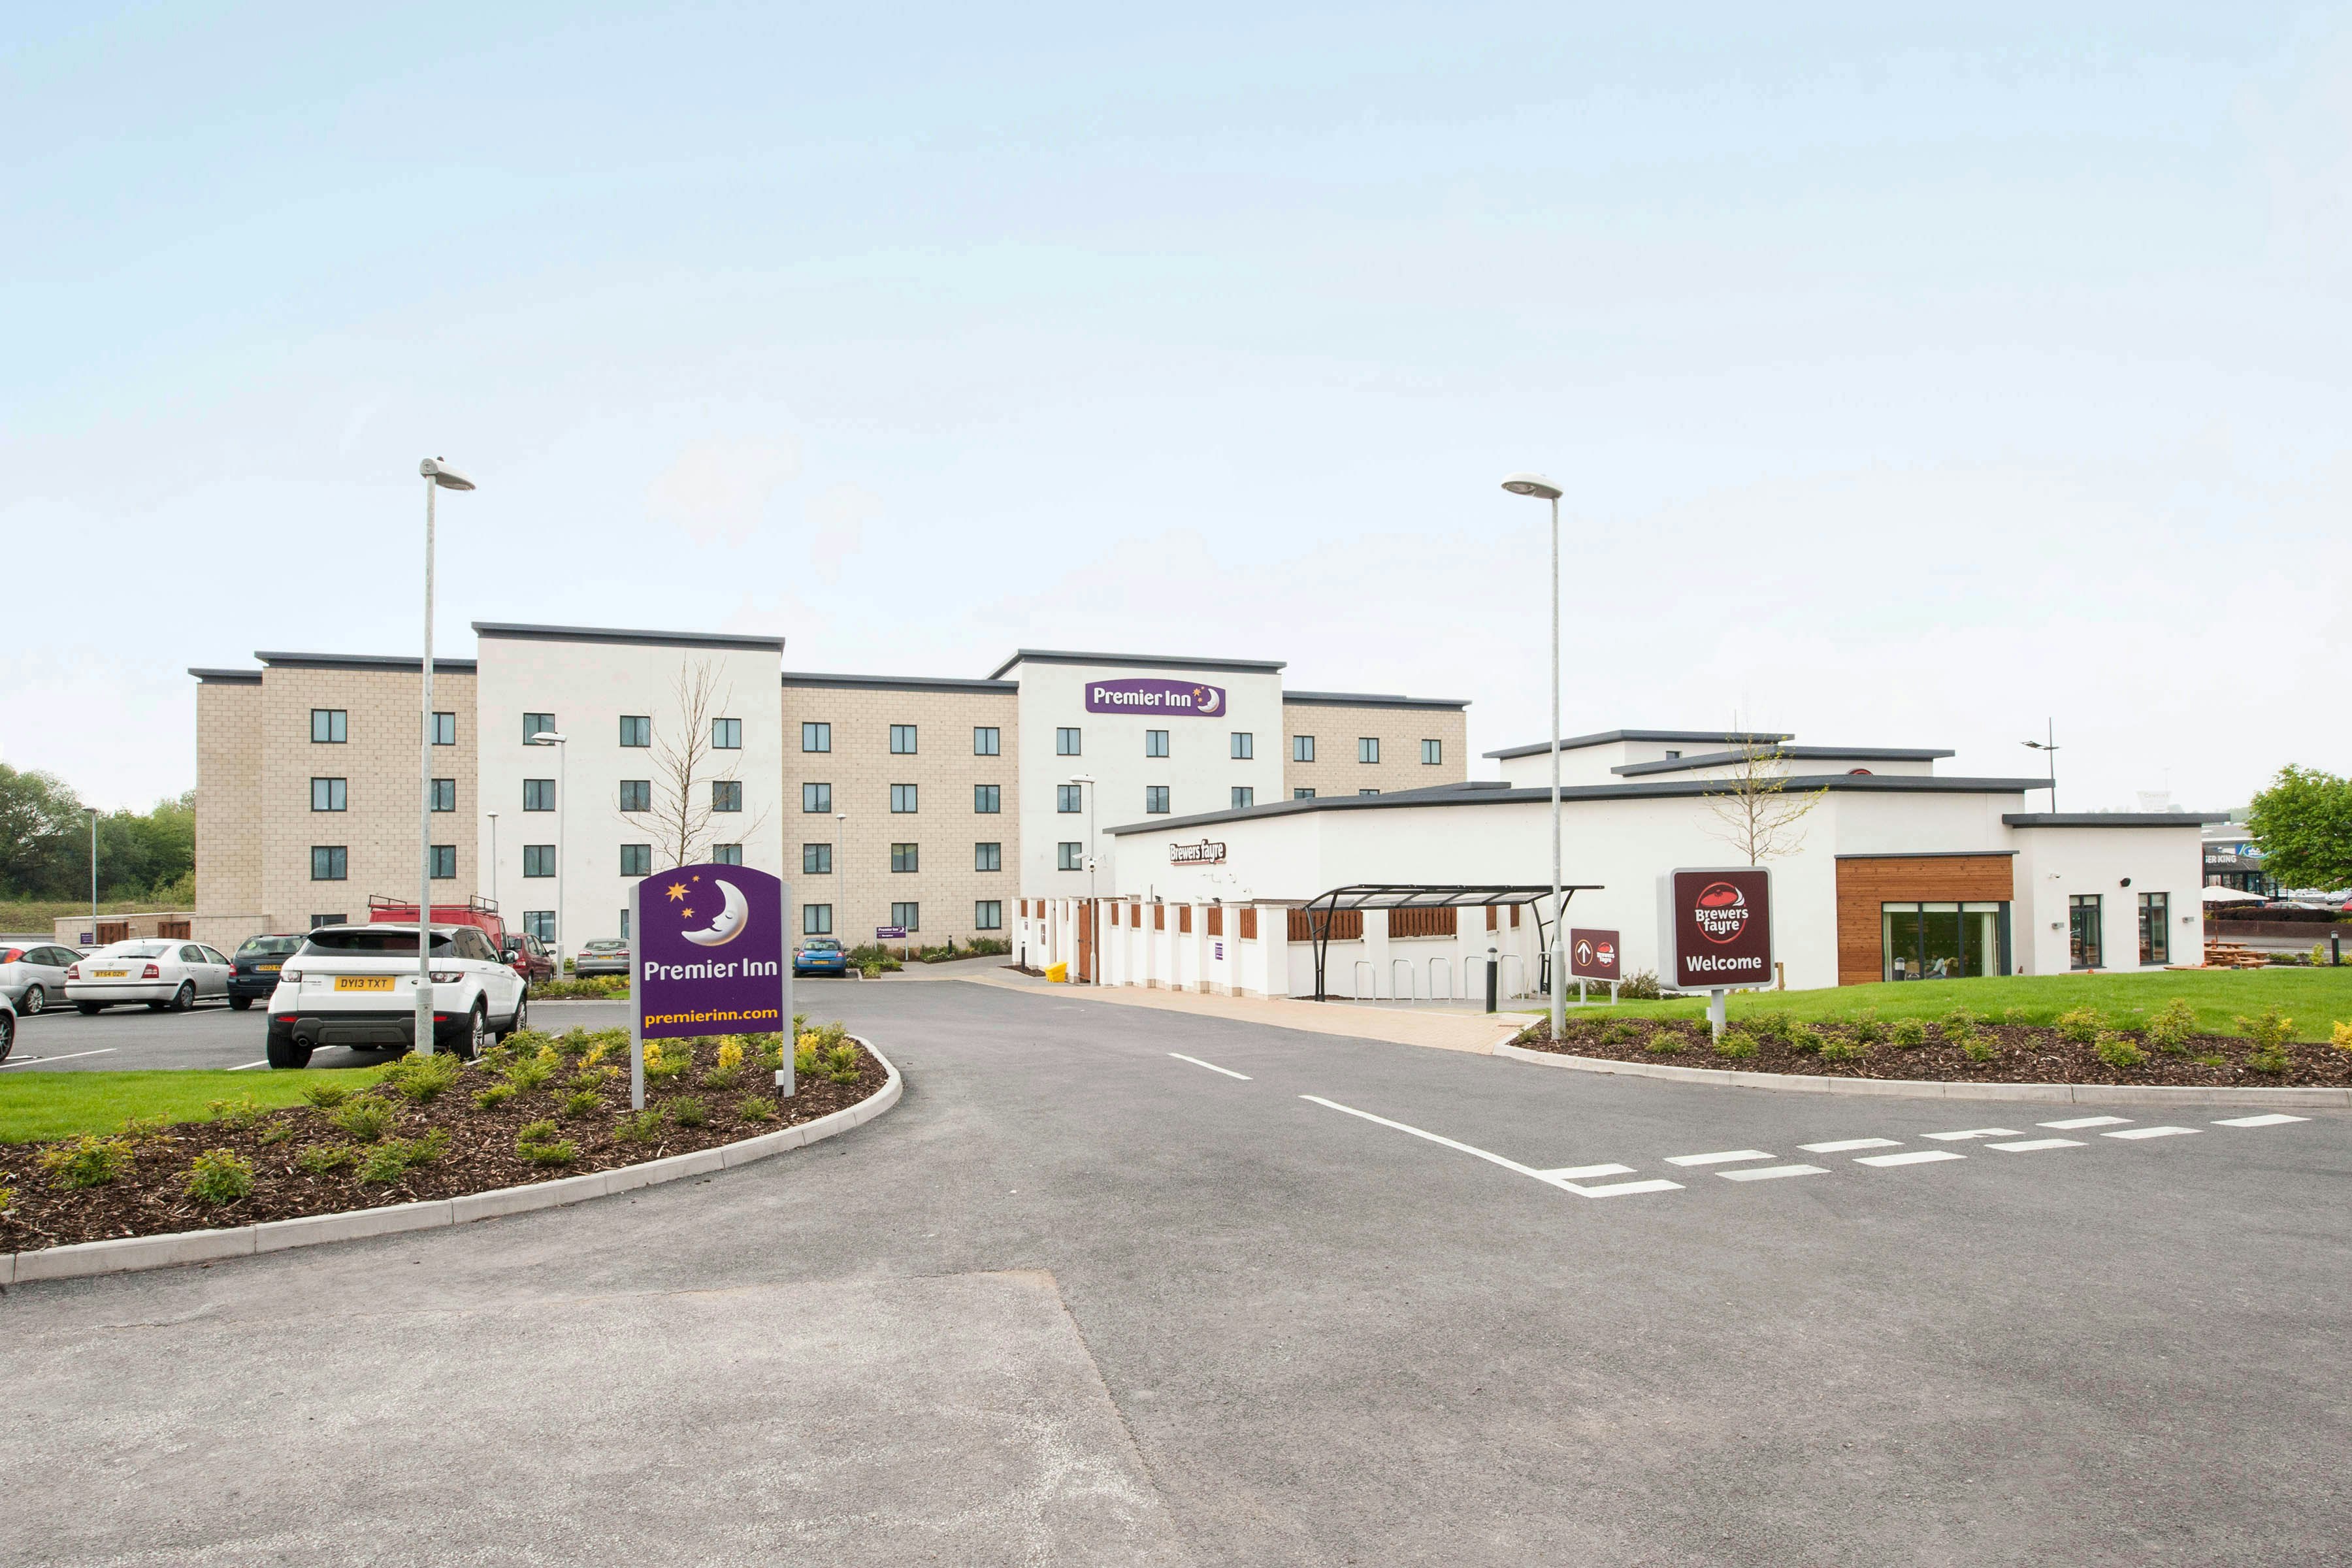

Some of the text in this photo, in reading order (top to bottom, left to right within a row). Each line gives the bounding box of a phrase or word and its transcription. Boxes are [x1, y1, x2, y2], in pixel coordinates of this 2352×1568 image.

[1094, 687, 1191, 707] Premier Inn
[1170, 839, 1224, 864] Brewers fayre
[1695, 909, 1749, 922] Brewers
[1704, 918, 1740, 934] fayre
[644, 958, 777, 981] Premier Inn
[1686, 955, 1762, 972] Welcome
[340, 979, 387, 988] DY13 TXT
[644, 1009, 778, 1029] premierinn.com
